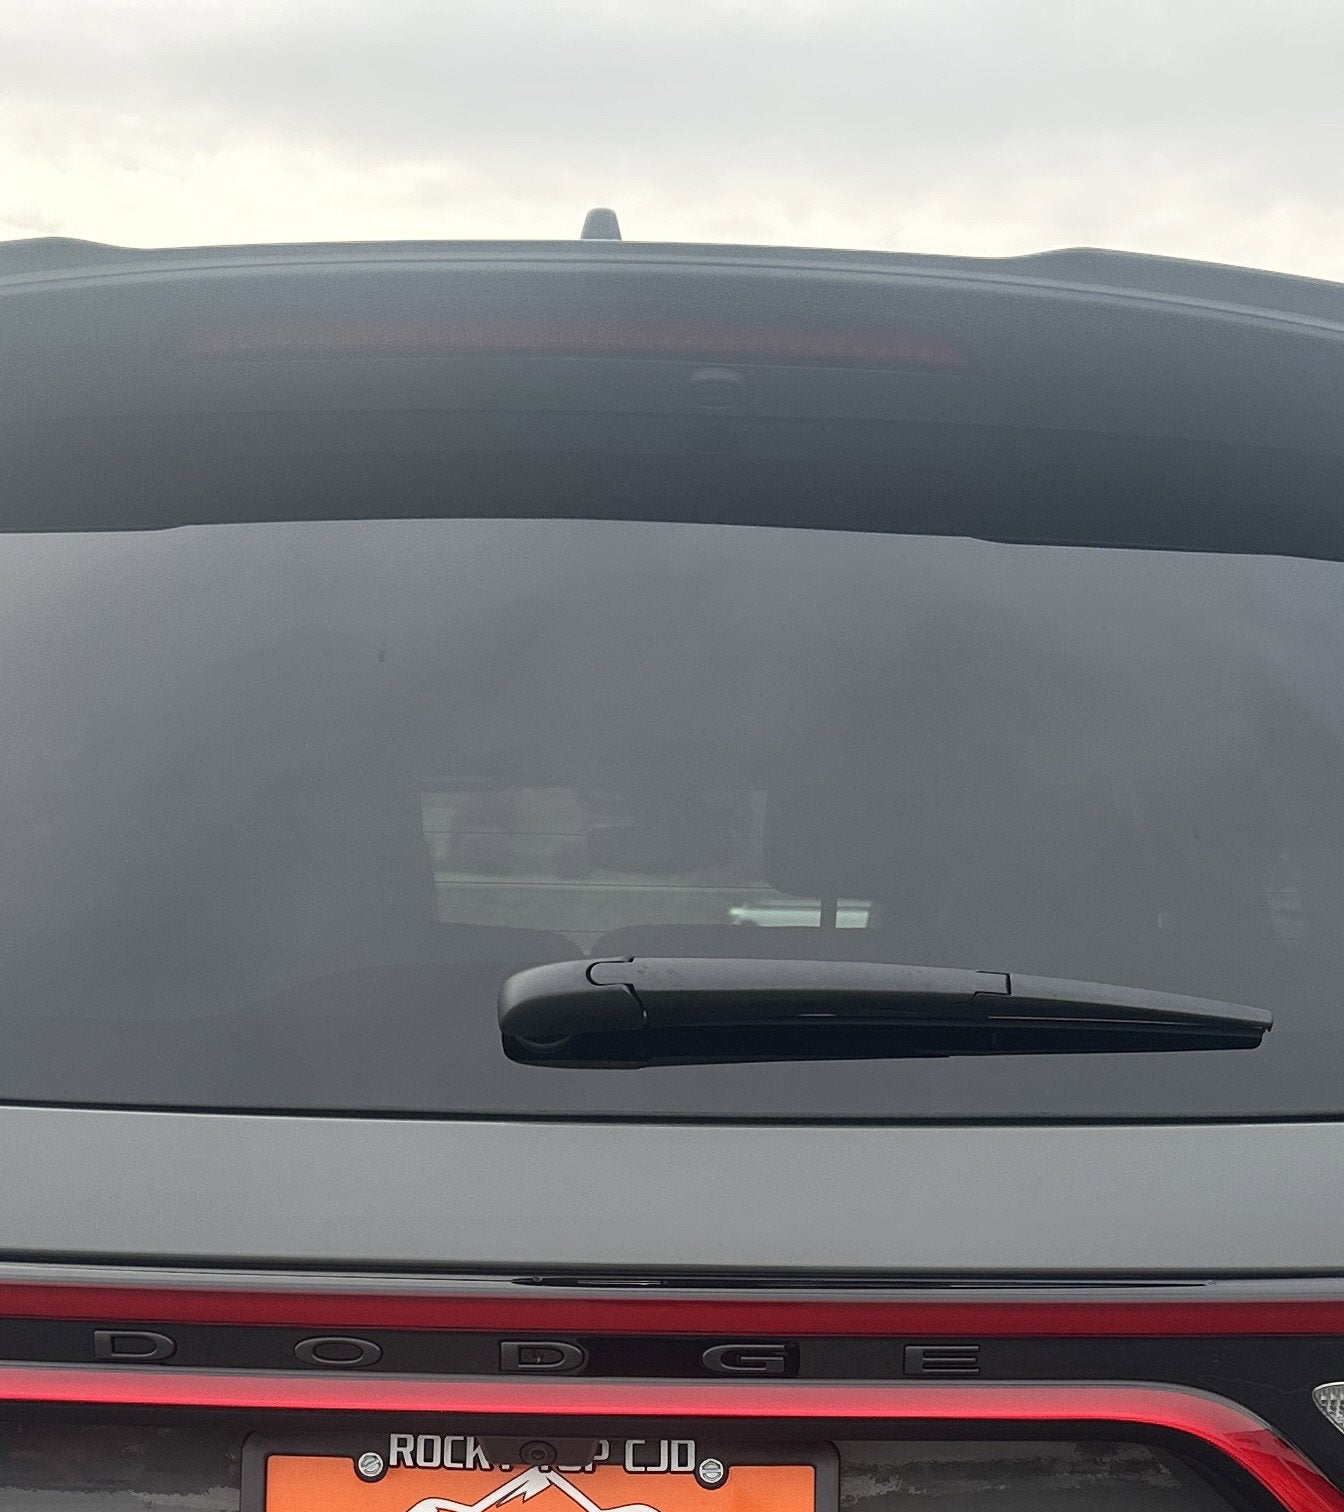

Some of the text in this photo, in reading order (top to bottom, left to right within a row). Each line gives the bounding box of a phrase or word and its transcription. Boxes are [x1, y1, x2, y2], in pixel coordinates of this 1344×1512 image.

[94, 1329, 983, 1375] DODGE
[389, 1433, 512, 1471] ROCK
[623, 1439, 696, 1473] CJD
